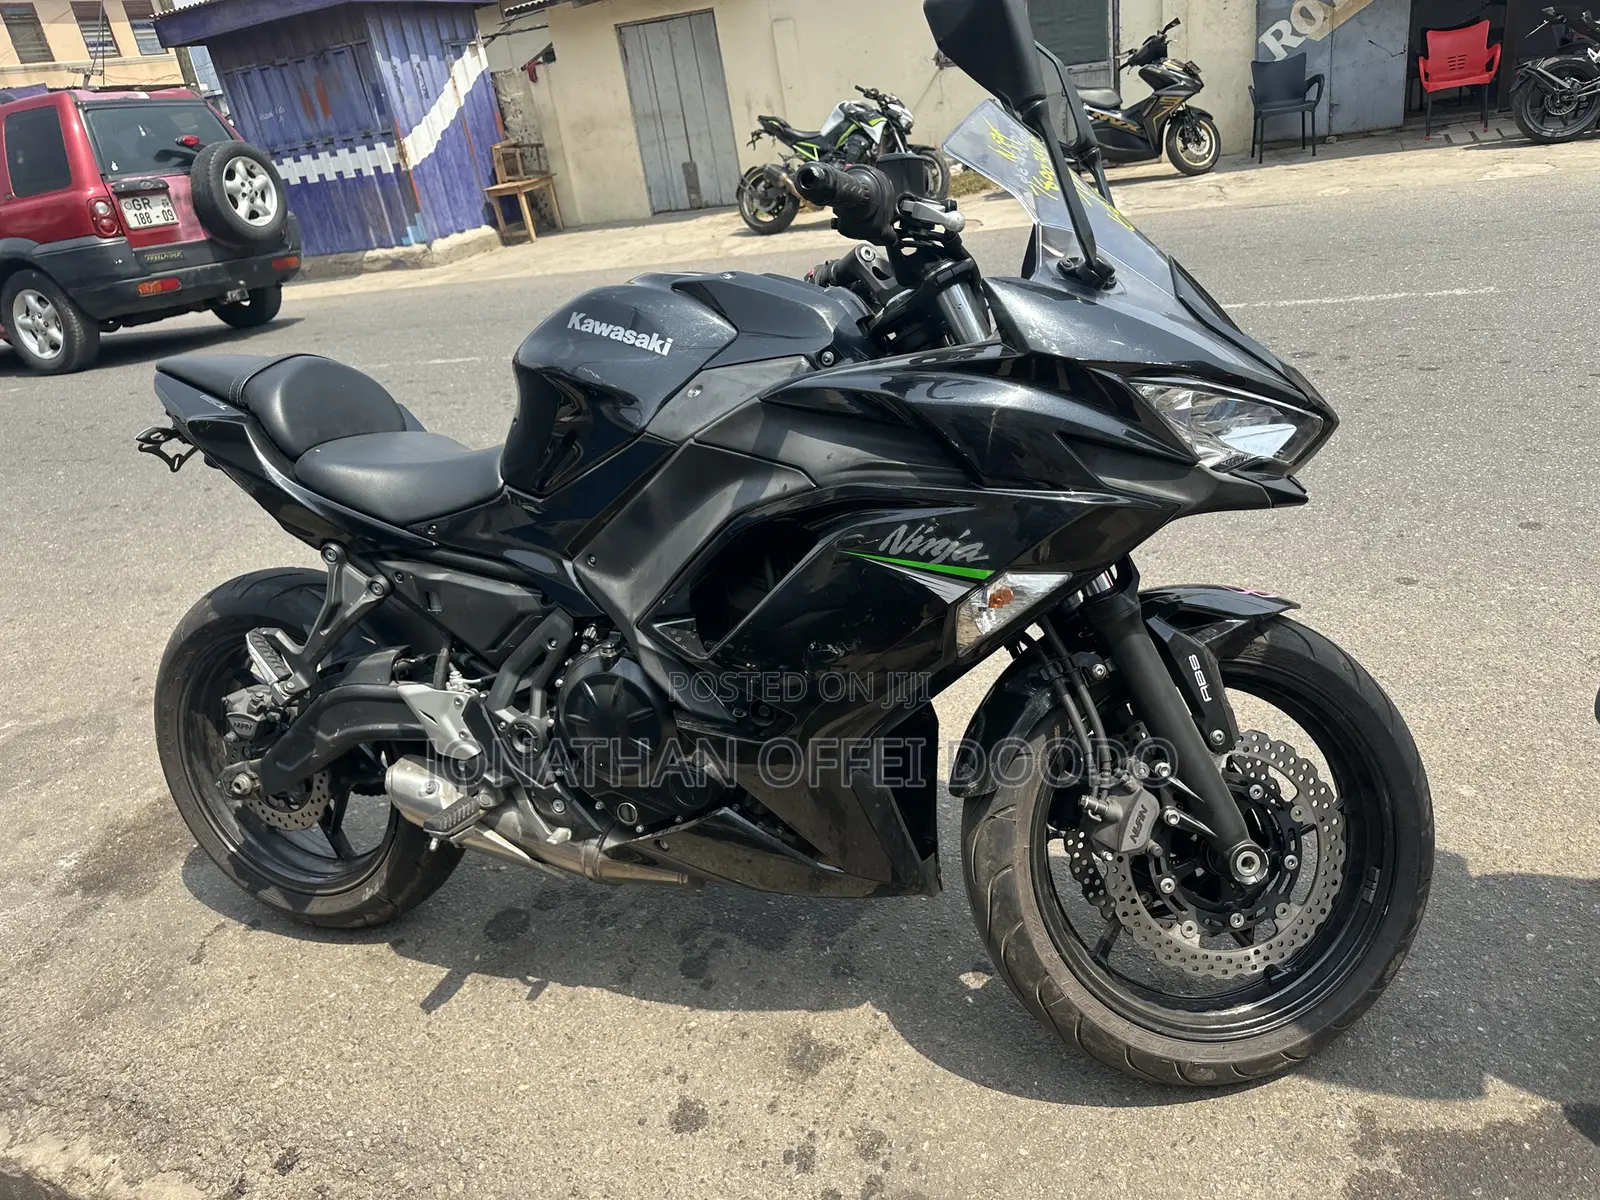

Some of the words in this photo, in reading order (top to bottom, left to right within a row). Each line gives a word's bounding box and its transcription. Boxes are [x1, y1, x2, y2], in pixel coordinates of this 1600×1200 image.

[1258, 0, 1349, 62] RO
[132, 197, 152, 211] GR
[134, 212, 152, 226] 188
[162, 209, 175, 222] 09
[567, 312, 674, 356] Kawasaki
[878, 524, 989, 568] Ninja
[1189, 654, 1212, 702] ABS
